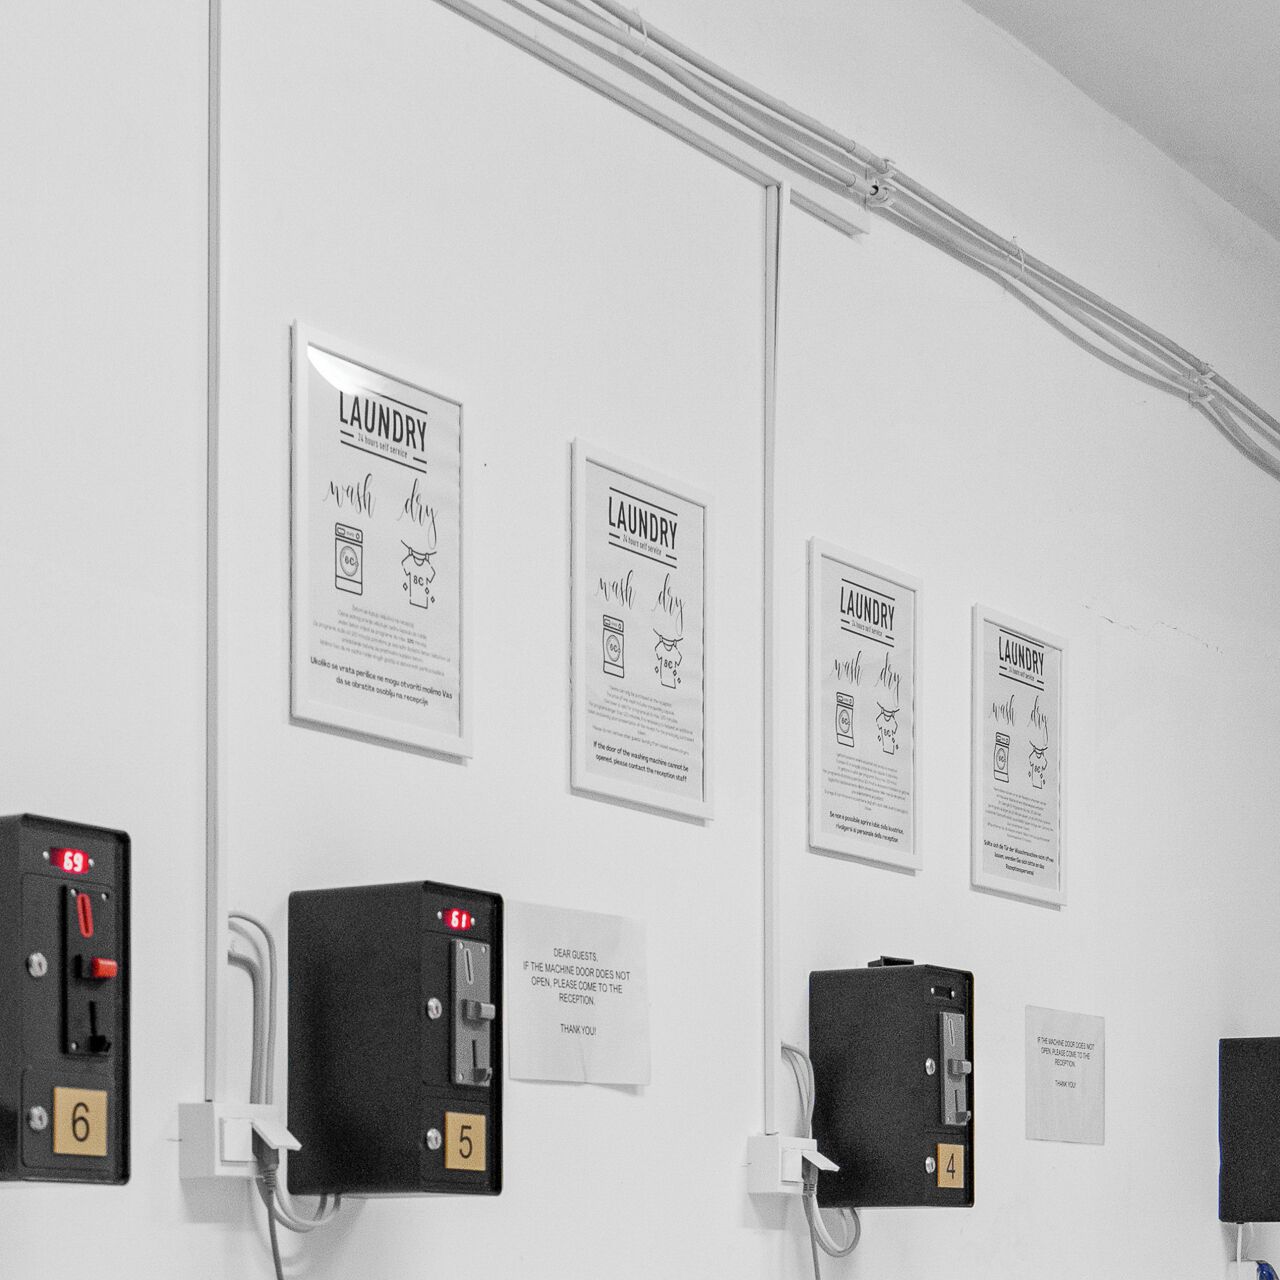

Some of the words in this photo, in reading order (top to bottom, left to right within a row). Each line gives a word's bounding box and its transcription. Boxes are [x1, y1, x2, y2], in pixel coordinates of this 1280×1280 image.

[340, 391, 426, 452] LAUNDRY
[365, 436, 379, 448] hours
[380, 442, 389, 452] self
[390, 447, 408, 459] service
[322, 473, 376, 518] wash
[397, 478, 438, 550] dry
[609, 496, 677, 549] LAUNDRY
[628, 537, 639, 548] hours
[648, 545, 662, 556] service
[593, 570, 636, 610] wash
[651, 573, 686, 636] dry
[841, 586, 895, 631] LAUNDRY
[999, 636, 1044, 676] LAUNDRY
[310, 656, 331, 668] Ukoliko
[332, 663, 338, 671] se
[339, 664, 355, 675] vrata
[377, 675, 384, 683] ne
[385, 677, 400, 688] mogu
[401, 681, 421, 692] otvoriti
[422, 687, 440, 697] molimo
[442, 691, 453, 699] Vas
[336, 676, 343, 685] da
[396, 692, 403, 700] na
[830, 650, 863, 686] wash
[874, 651, 902, 707] dry
[989, 694, 1016, 727] wash
[1027, 695, 1048, 746] dry
[606, 745, 616, 753] door
[630, 753, 649, 763] washing
[649, 757, 667, 766] machine
[667, 761, 683, 770] cannot
[614, 758, 628, 767] please
[629, 762, 646, 772] contact
[654, 769, 675, 780] reception
[676, 774, 688, 782] staff
[63, 851, 84, 872] 69
[451, 911, 467, 928] 61
[553, 947, 571, 958] DEAR
[523, 960, 529, 970] IF
[531, 961, 543, 972] THE
[545, 963, 574, 976] MACHINE
[575, 966, 594, 977] DOOR
[595, 968, 614, 979] DOES
[615, 970, 630, 981] NOT
[553, 978, 577, 990] PLEASE
[578, 980, 597, 992] COME
[598, 982, 607, 993] TO
[609, 983, 623, 994] THE
[560, 1023, 580, 1035] THANK
[581, 1025, 597, 1036] YOU!
[72, 1102, 90, 1142] 6
[459, 1125, 473, 1159] 5
[946, 1153, 956, 1179] 4
